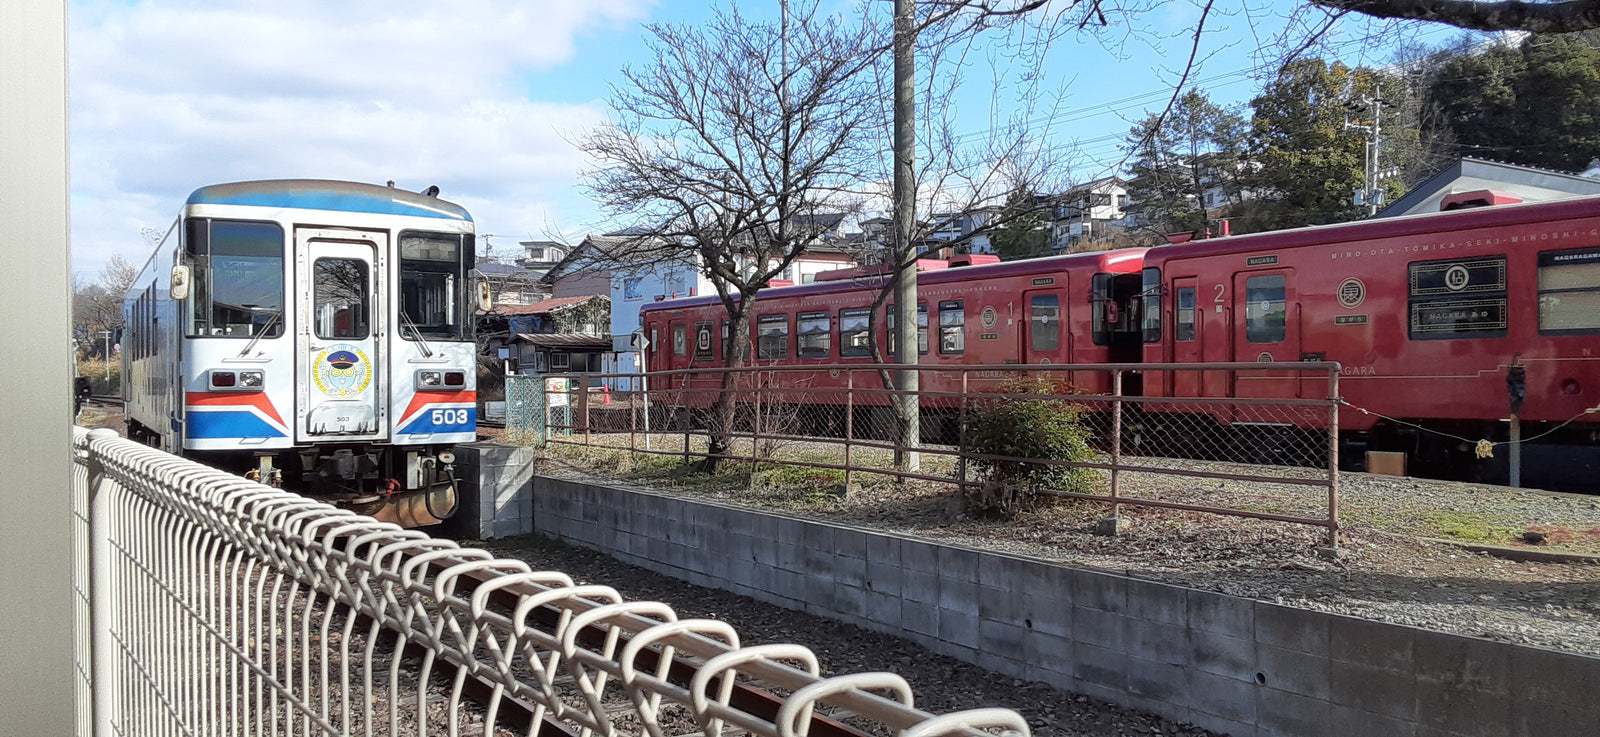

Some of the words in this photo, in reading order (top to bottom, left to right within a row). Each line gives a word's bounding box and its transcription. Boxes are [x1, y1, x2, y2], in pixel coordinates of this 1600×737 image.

[1213, 283, 1225, 303] 2
[1007, 300, 1014, 317] 1
[1428, 311, 1467, 320] NAGARA
[431, 408, 469, 426] 503
